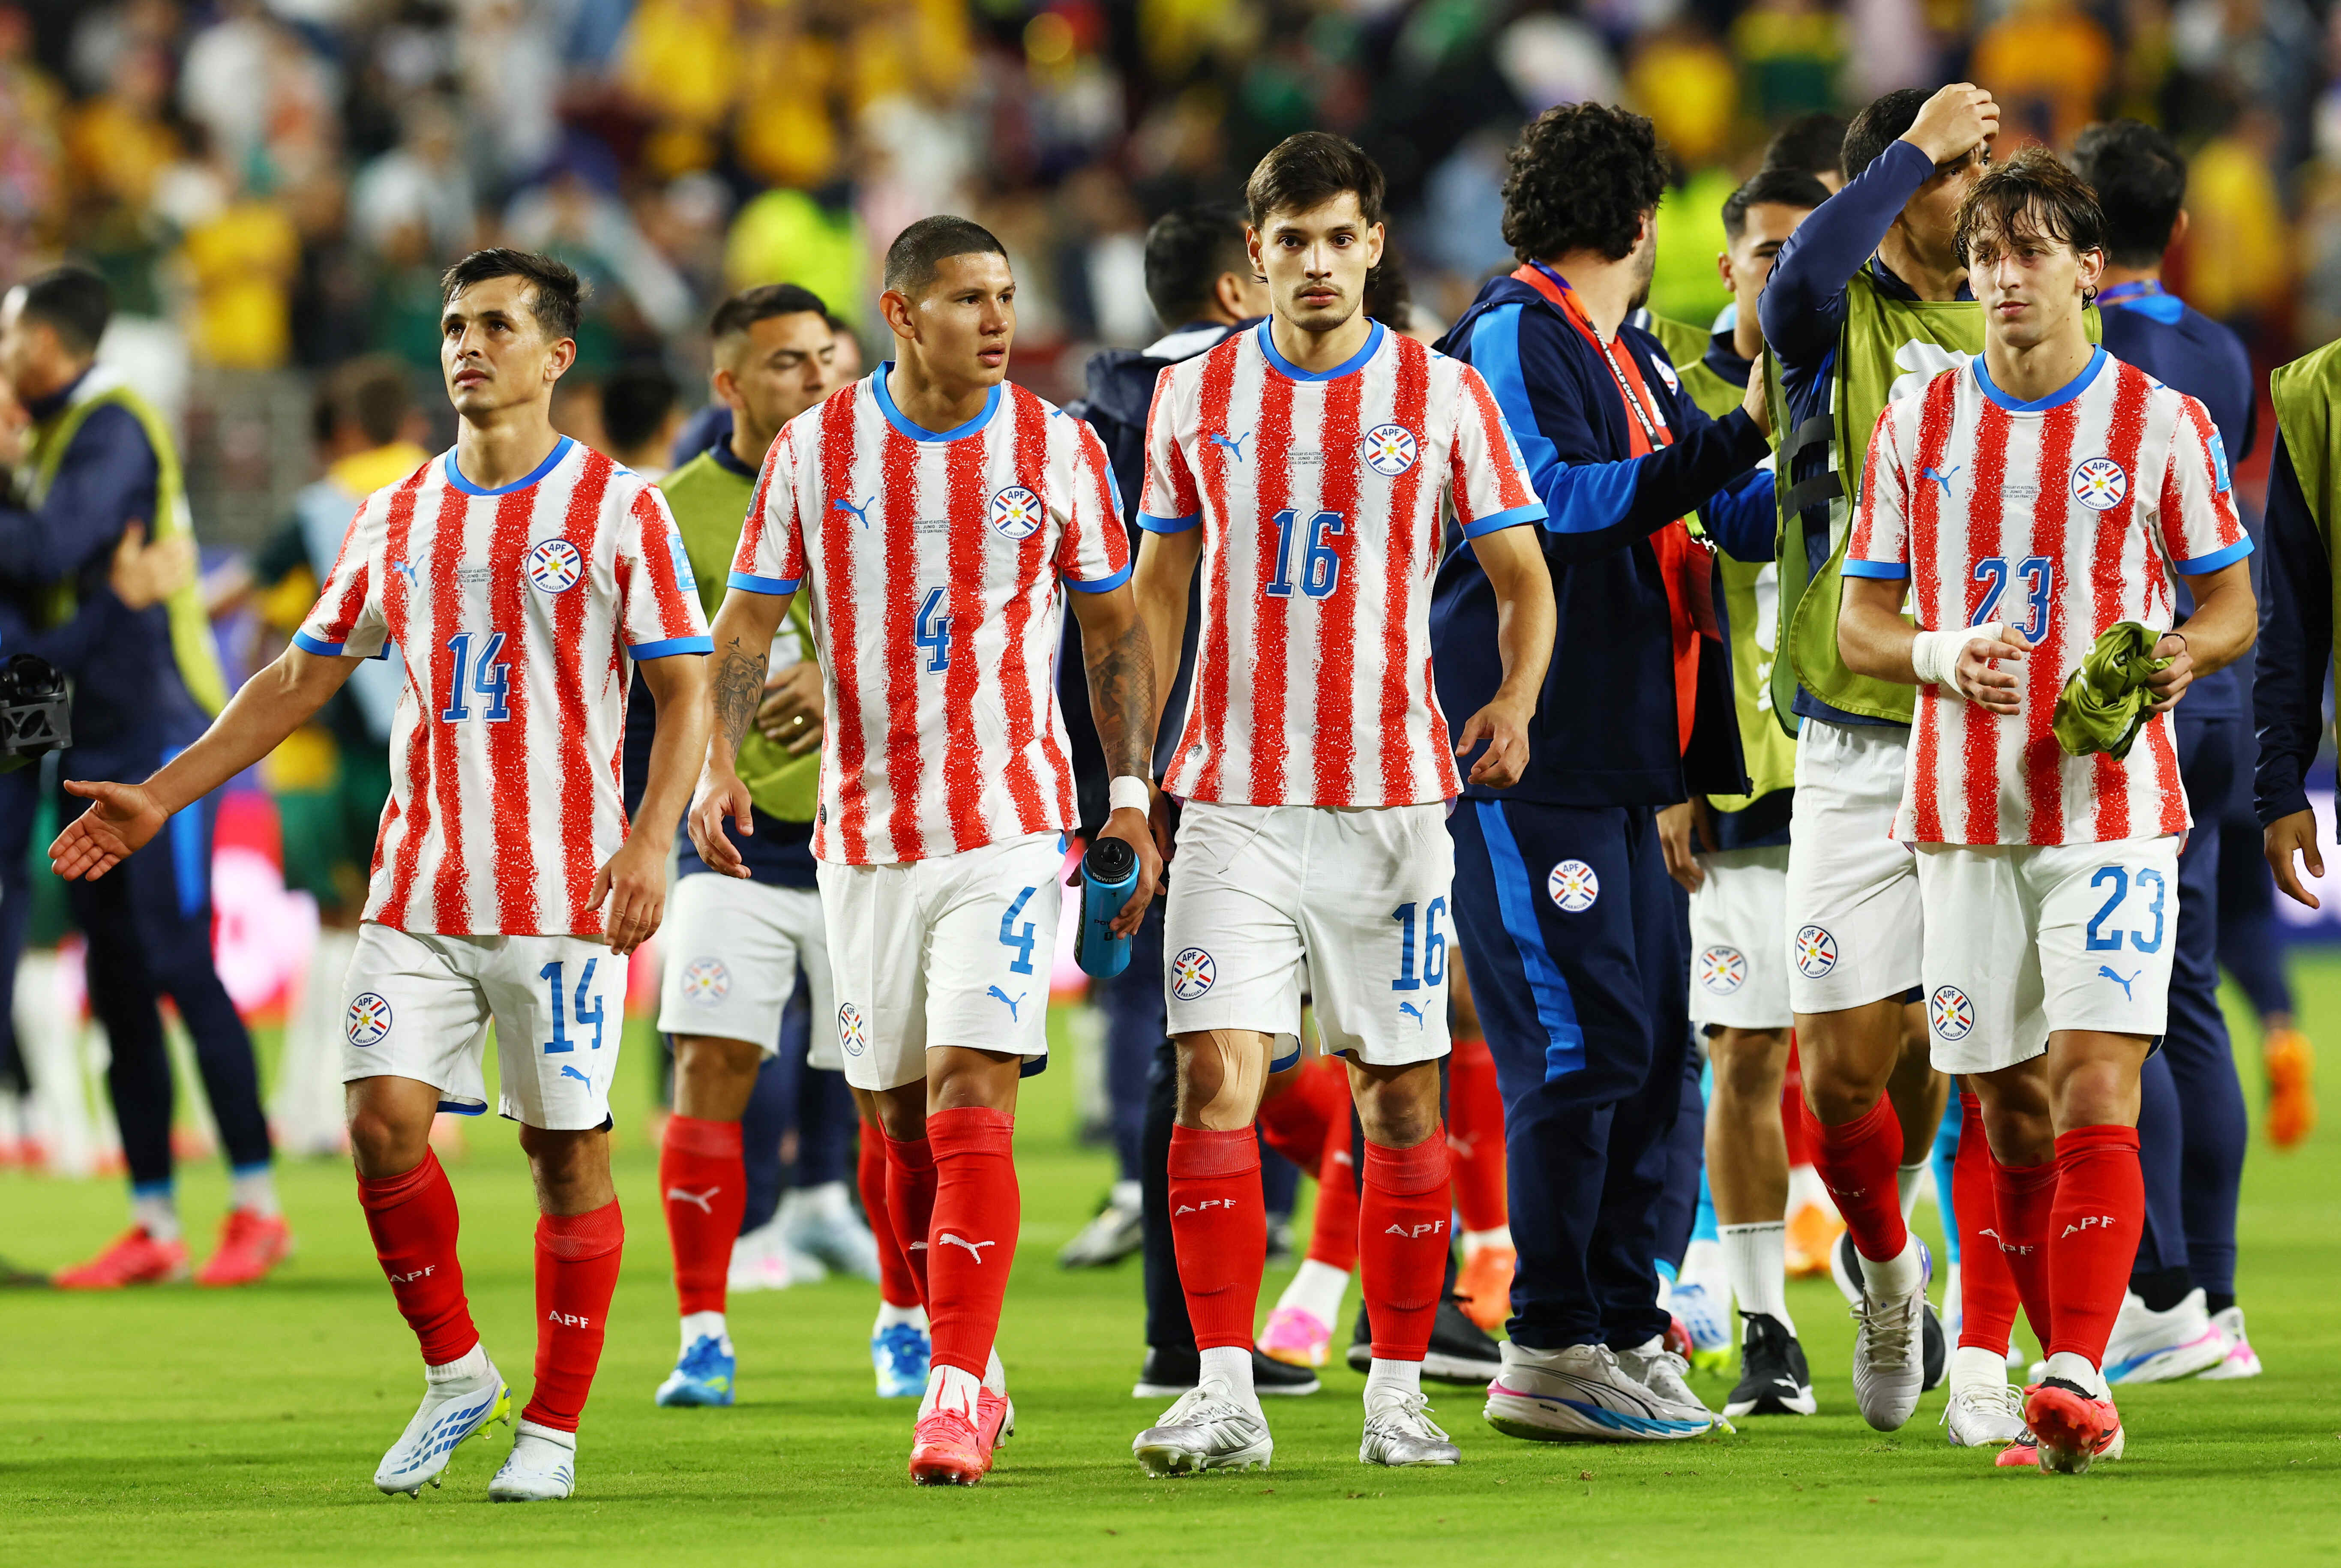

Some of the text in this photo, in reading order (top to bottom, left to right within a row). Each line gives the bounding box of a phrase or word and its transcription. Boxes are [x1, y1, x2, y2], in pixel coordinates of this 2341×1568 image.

[1605, 349, 1626, 384] WORLD
[1623, 383, 1637, 402] CUP
[548, 543, 566, 552] APF
[1266, 509, 1345, 600] 16
[540, 582, 564, 590] PARAGUAY
[1972, 556, 2054, 646] 23
[914, 587, 953, 675] 4
[442, 632, 512, 723] 14
[1563, 863, 1579, 872] APF
[1093, 872, 1131, 883] POWERADE
[2086, 866, 2165, 954] 23
[999, 887, 1037, 975] 4
[1804, 929, 1815, 939] APF
[1391, 895, 1446, 991] 16
[1182, 951, 1196, 962] APF
[1807, 966, 1827, 975] PARAGUAY
[1181, 989, 1202, 997] PARAGUAY
[1943, 990, 1955, 999] APF
[358, 997, 373, 1007] APF
[540, 958, 604, 1054] 14
[1175, 1199, 1236, 1216] APF
[1385, 1220, 1445, 1238] APF
[2061, 1216, 2116, 1238] APF
[390, 1265, 435, 1282] APF
[549, 1310, 589, 1329] APF
